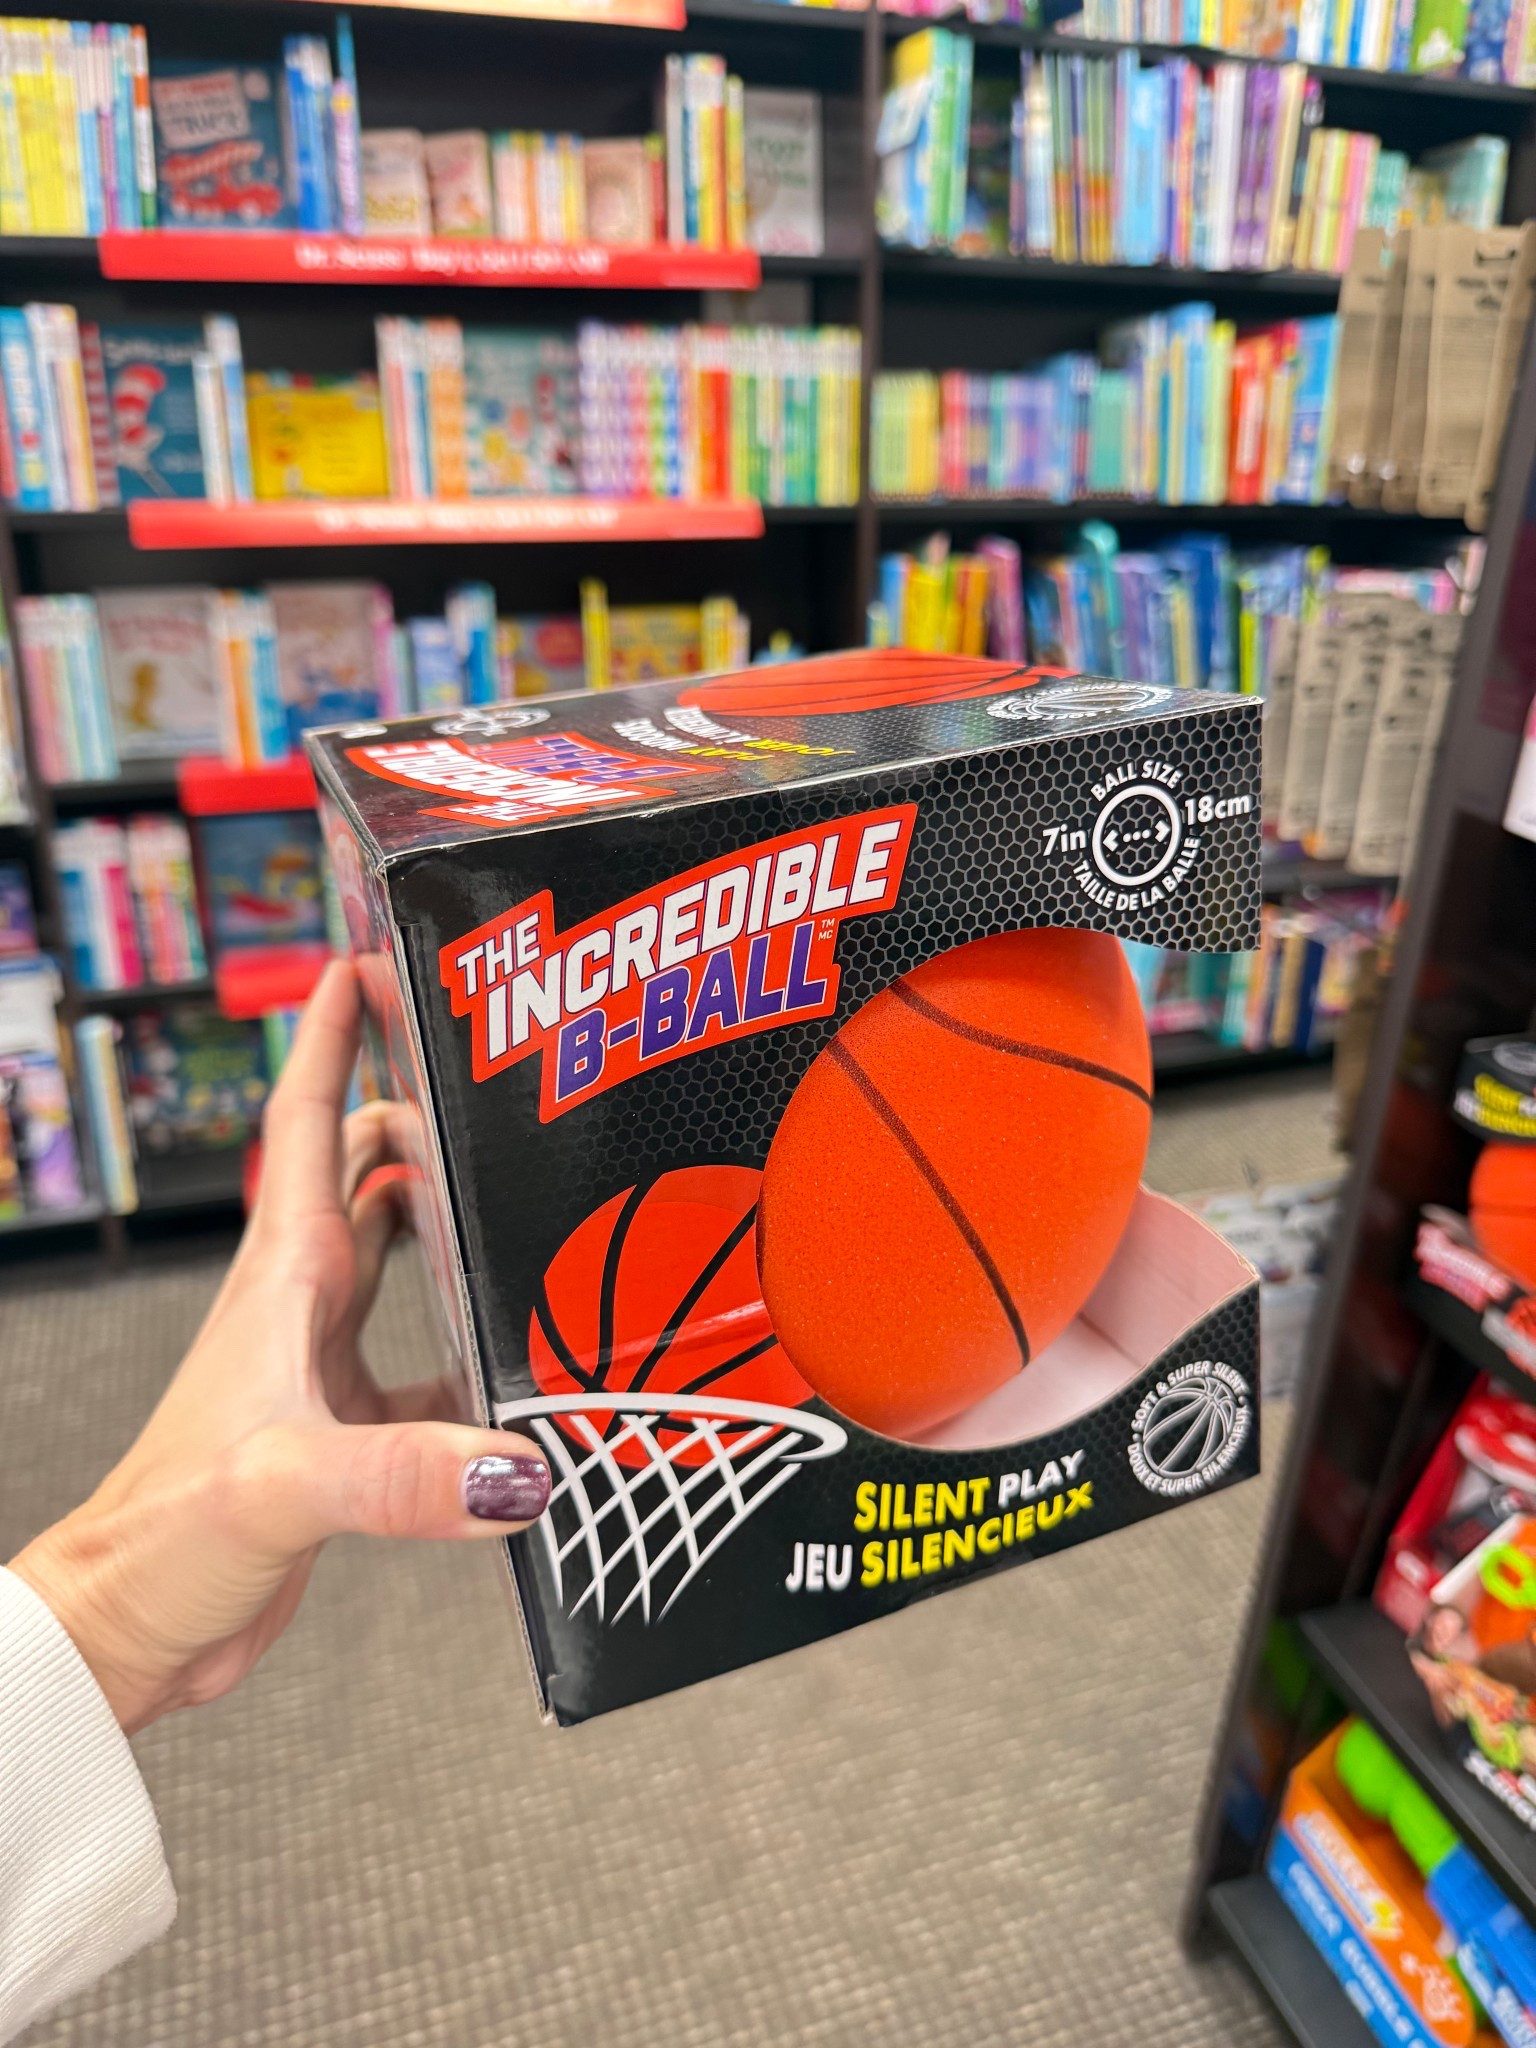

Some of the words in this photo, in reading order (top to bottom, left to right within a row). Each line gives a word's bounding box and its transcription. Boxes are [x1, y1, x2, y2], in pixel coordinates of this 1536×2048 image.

[362, 741, 645, 807] INCREDIBLE
[679, 746, 773, 761] PLAY
[744, 738, 855, 756] JOUER
[1090, 761, 1137, 802] BALL
[1141, 759, 1183, 789] SIZE
[449, 802, 557, 821] THE
[1042, 824, 1087, 857] 7in
[1184, 794, 1251, 826] 18cm
[1073, 860, 1114, 911] TAILLE
[1115, 894, 1139, 911] DE
[1141, 889, 1165, 908] LA
[1162, 836, 1200, 893] BALLE
[456, 910, 542, 998] THE
[486, 819, 904, 1063] INCREDIBLE
[820, 918, 836, 929] TM
[555, 920, 828, 1104] B-BALL
[1131, 1391, 1158, 1431] SOFT
[1156, 1381, 1169, 1397] &
[1167, 1360, 1213, 1386] SUPER
[1212, 1361, 1250, 1396] SILENT
[1127, 1442, 1150, 1484] DOUX
[1144, 1472, 1160, 1493] ET
[1159, 1472, 1206, 1497] SUPER
[1201, 1404, 1252, 1485] SILENCIEUX
[853, 1478, 992, 1533] SILENT
[997, 1449, 1087, 1508] PLAY
[785, 1542, 853, 1593] JEU
[860, 1480, 1095, 1588] SILENCIEUX
